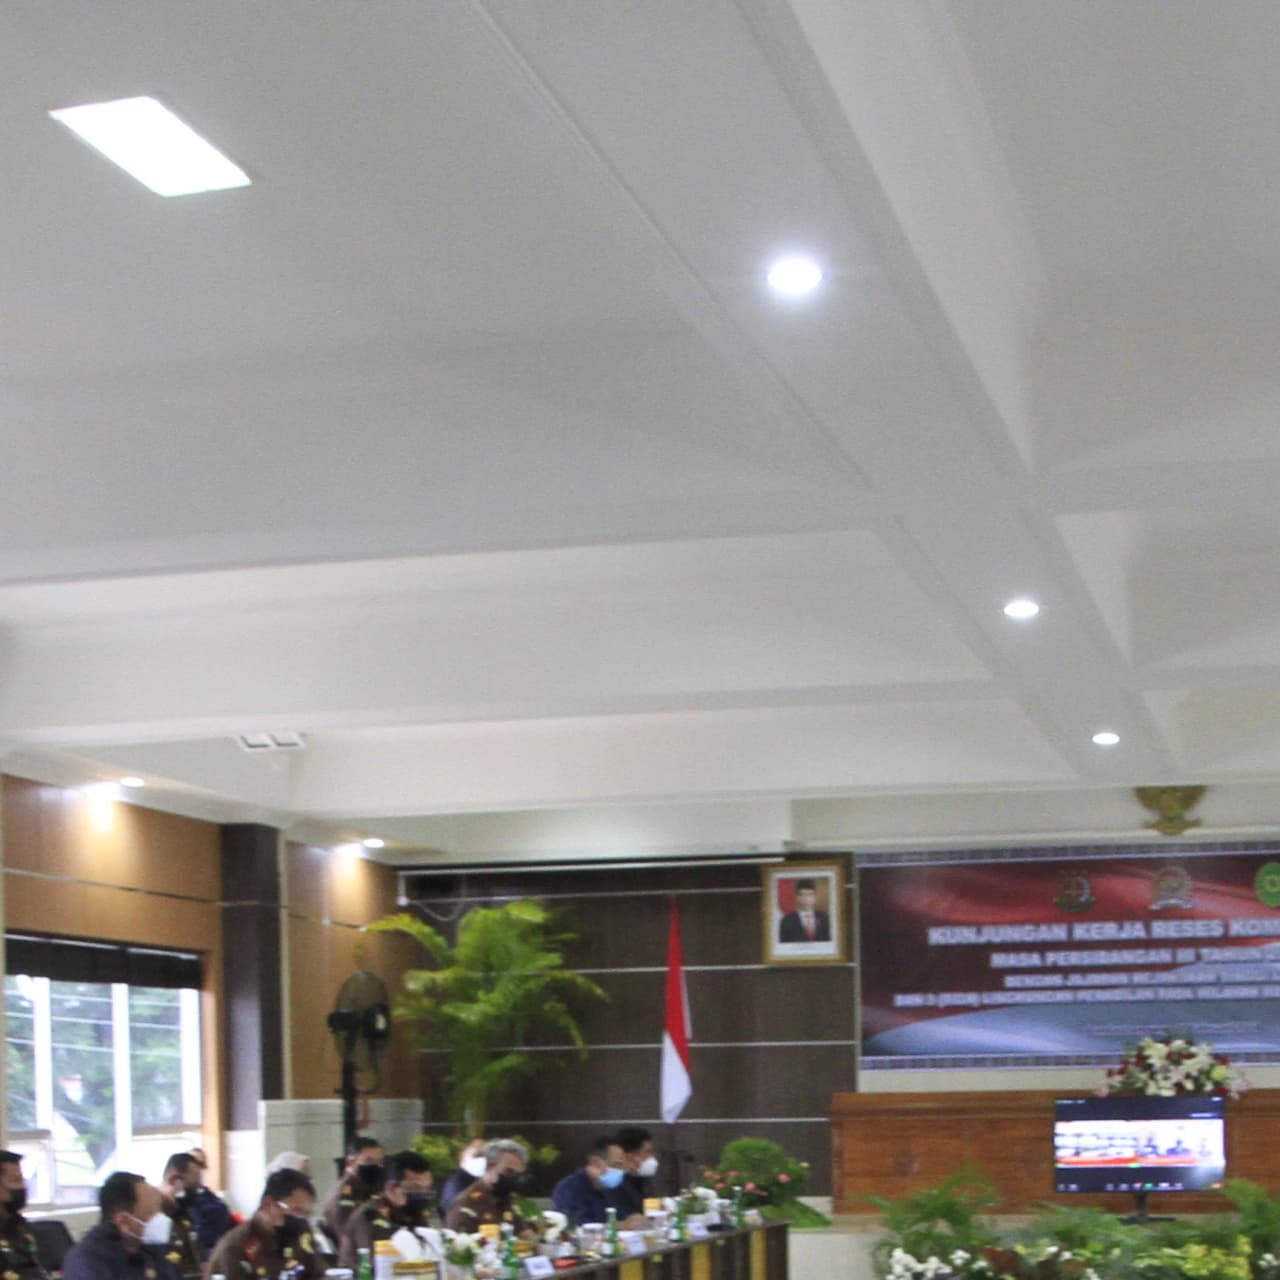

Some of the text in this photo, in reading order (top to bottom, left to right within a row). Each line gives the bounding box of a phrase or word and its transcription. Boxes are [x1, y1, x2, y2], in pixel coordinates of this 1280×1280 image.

[928, 923, 1069, 945] KUNJUNGAN
[1072, 920, 1146, 941] KERJA
[1151, 918, 1224, 940] RESES
[990, 952, 1041, 968] MASA
[1045, 948, 1173, 967] PERSIDANGAN
